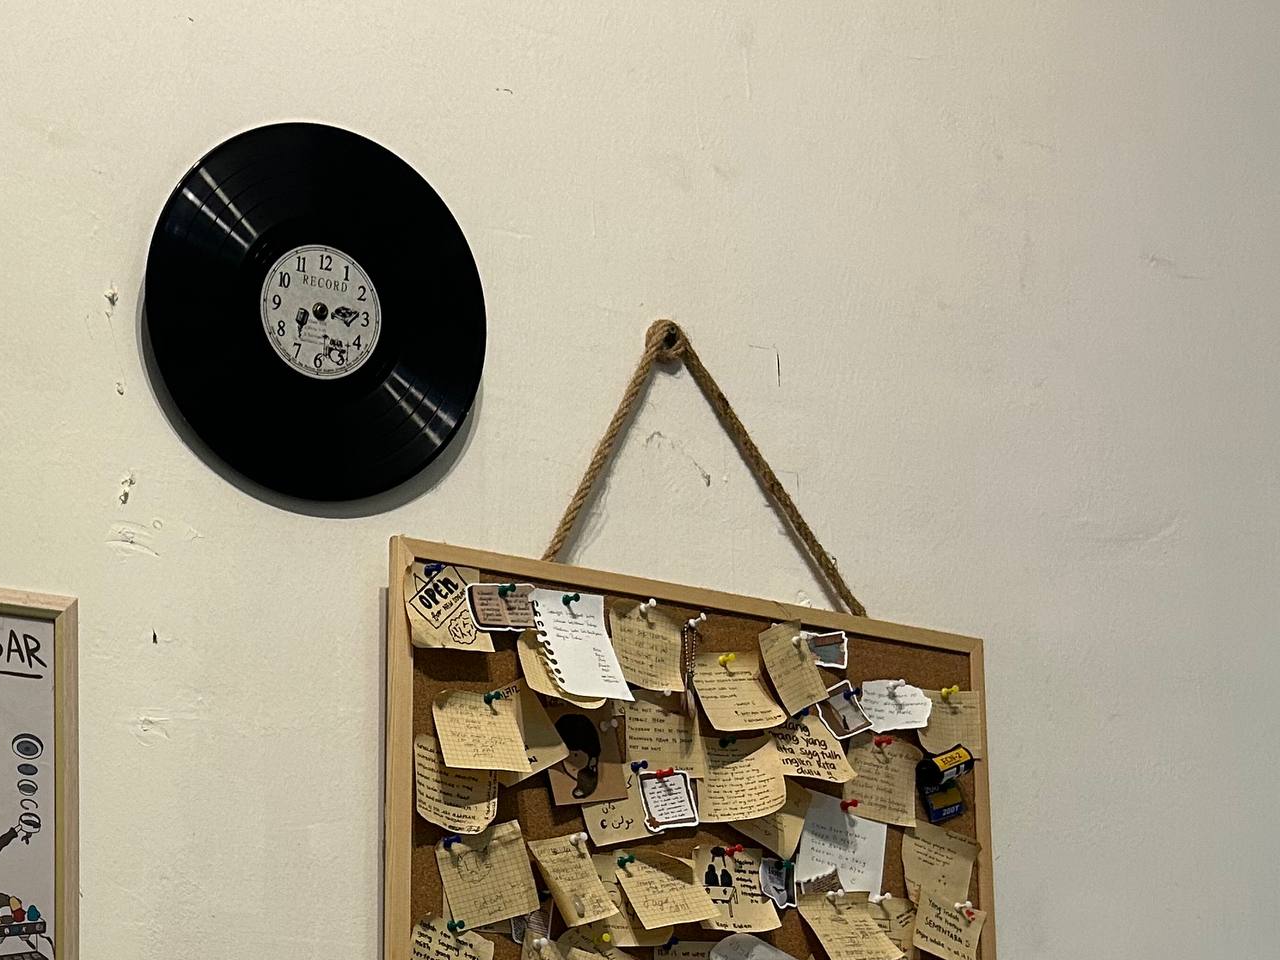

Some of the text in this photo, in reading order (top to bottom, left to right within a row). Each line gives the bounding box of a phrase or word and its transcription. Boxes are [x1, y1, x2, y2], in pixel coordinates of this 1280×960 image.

[296, 256, 306, 273] 11
[320, 254, 333, 271] 12
[279, 271, 291, 288] 10
[344, 265, 350, 282] 1
[302, 274, 348, 293] RECORD
[272, 294, 282, 310] 9
[357, 285, 367, 302] 2
[360, 311, 370, 327] 3
[277, 320, 286, 337] 8
[293, 342, 302, 359] 7
[352, 334, 362, 350] 4
[313, 352, 323, 369] 6
